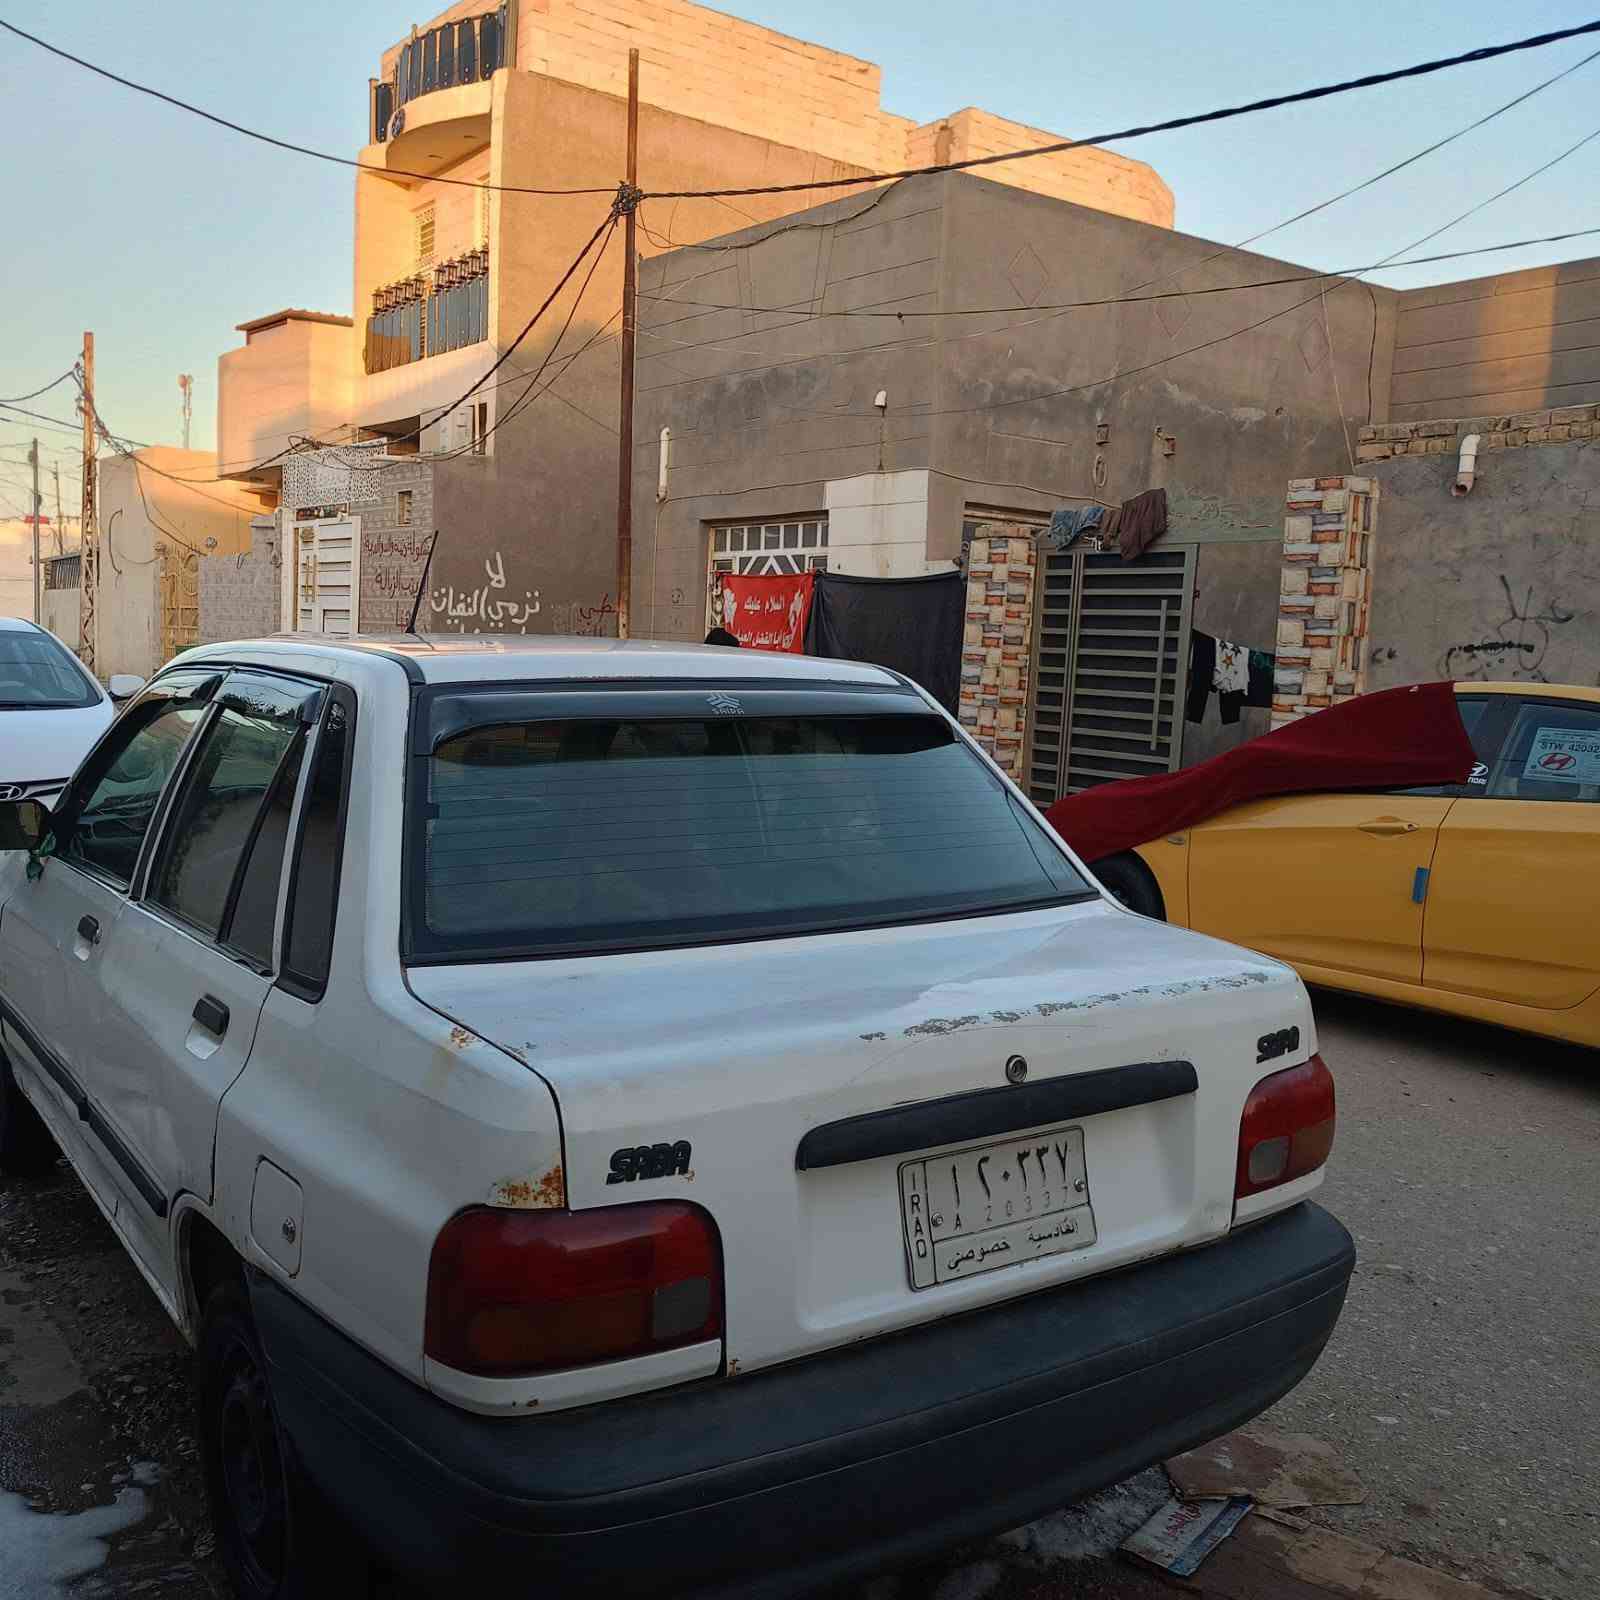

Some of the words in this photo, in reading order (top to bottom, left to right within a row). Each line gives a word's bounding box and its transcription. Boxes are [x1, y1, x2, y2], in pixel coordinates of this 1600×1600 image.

[486, 551, 506, 588] لا
[743, 595, 761, 615] عليك
[765, 594, 785, 616] السلام
[711, 707, 744, 717] SAIPA
[1028, 1220, 1079, 1249] القادسية
[947, 1239, 1011, 1272] خصوصي
